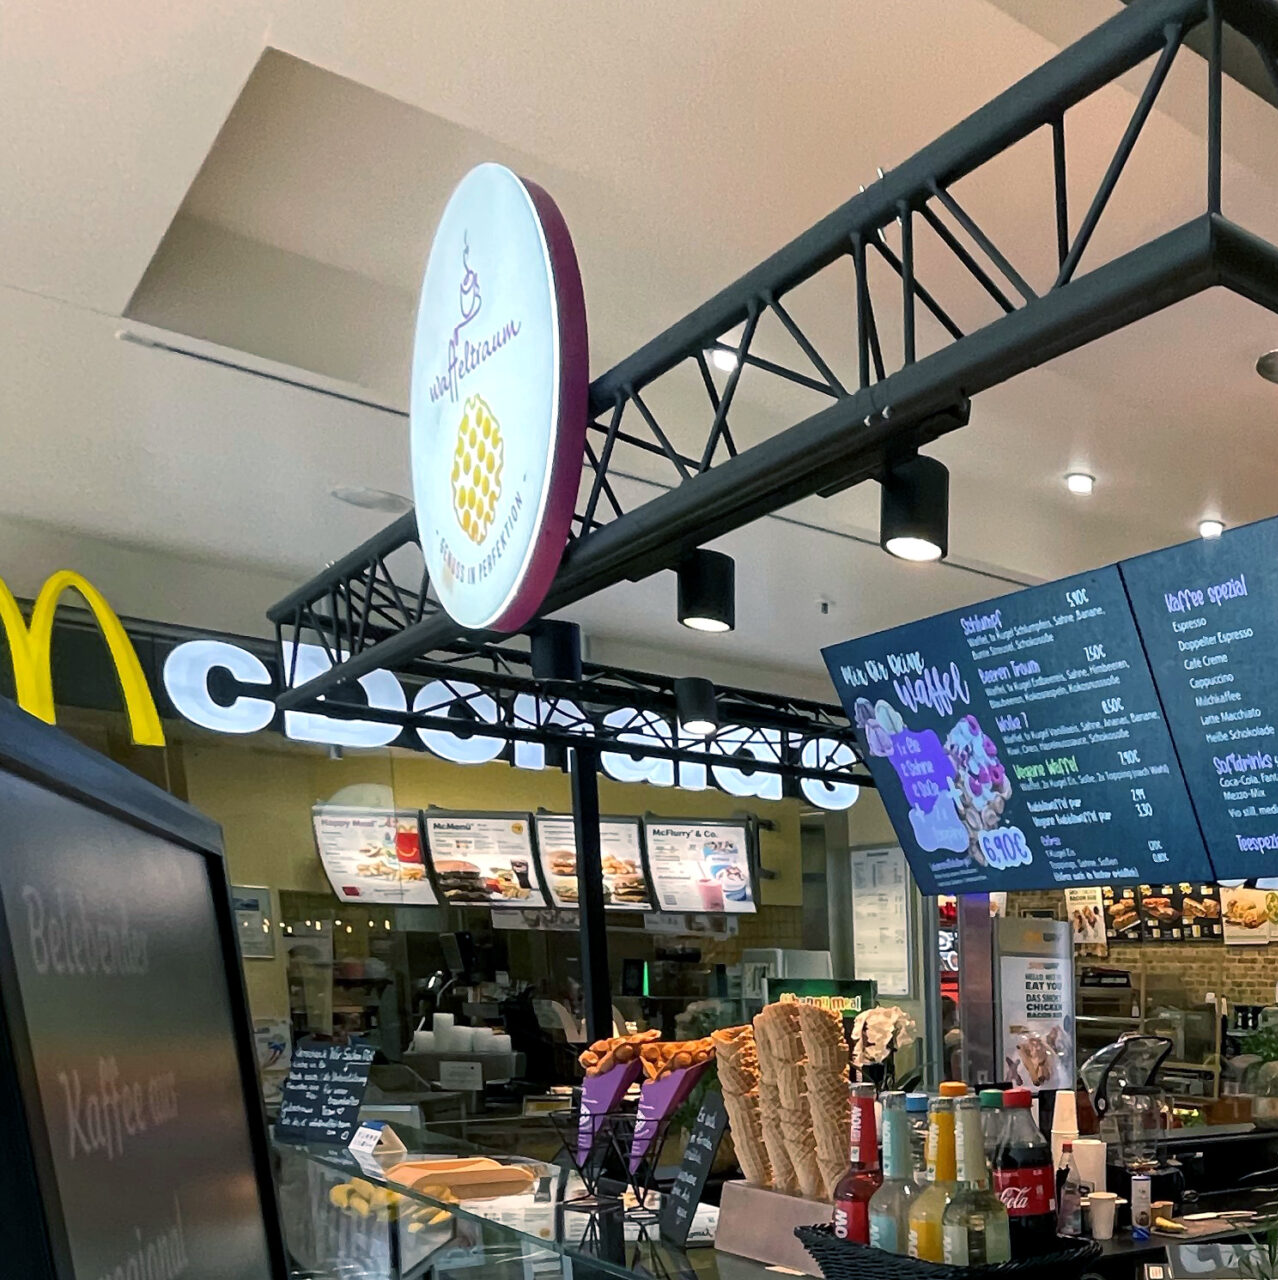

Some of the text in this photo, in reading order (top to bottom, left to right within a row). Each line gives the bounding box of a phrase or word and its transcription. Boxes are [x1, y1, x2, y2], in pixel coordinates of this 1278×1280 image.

[429, 319, 522, 403] waffeltraum
[467, 570, 476, 585] IN
[478, 491, 524, 583] PERFEKTION
[1164, 573, 1249, 614] Kaffee spezial
[1172, 616, 1207, 633] Espresso
[1217, 627, 1254, 644] Espresso
[893, 661, 970, 717] Waffel
[1189, 673, 1235, 690] Cappuccino
[1230, 724, 1275, 740] Schokolade
[1213, 750, 1273, 776] Softdrinks
[652, 828, 693, 839] McFlurry
[703, 829, 718, 838] Co.
[983, 832, 1028, 864] 6,90€
[1025, 981, 1044, 990] EAT
[1026, 993, 1041, 1002] DAS
[56, 1056, 147, 1162] Kaffee
